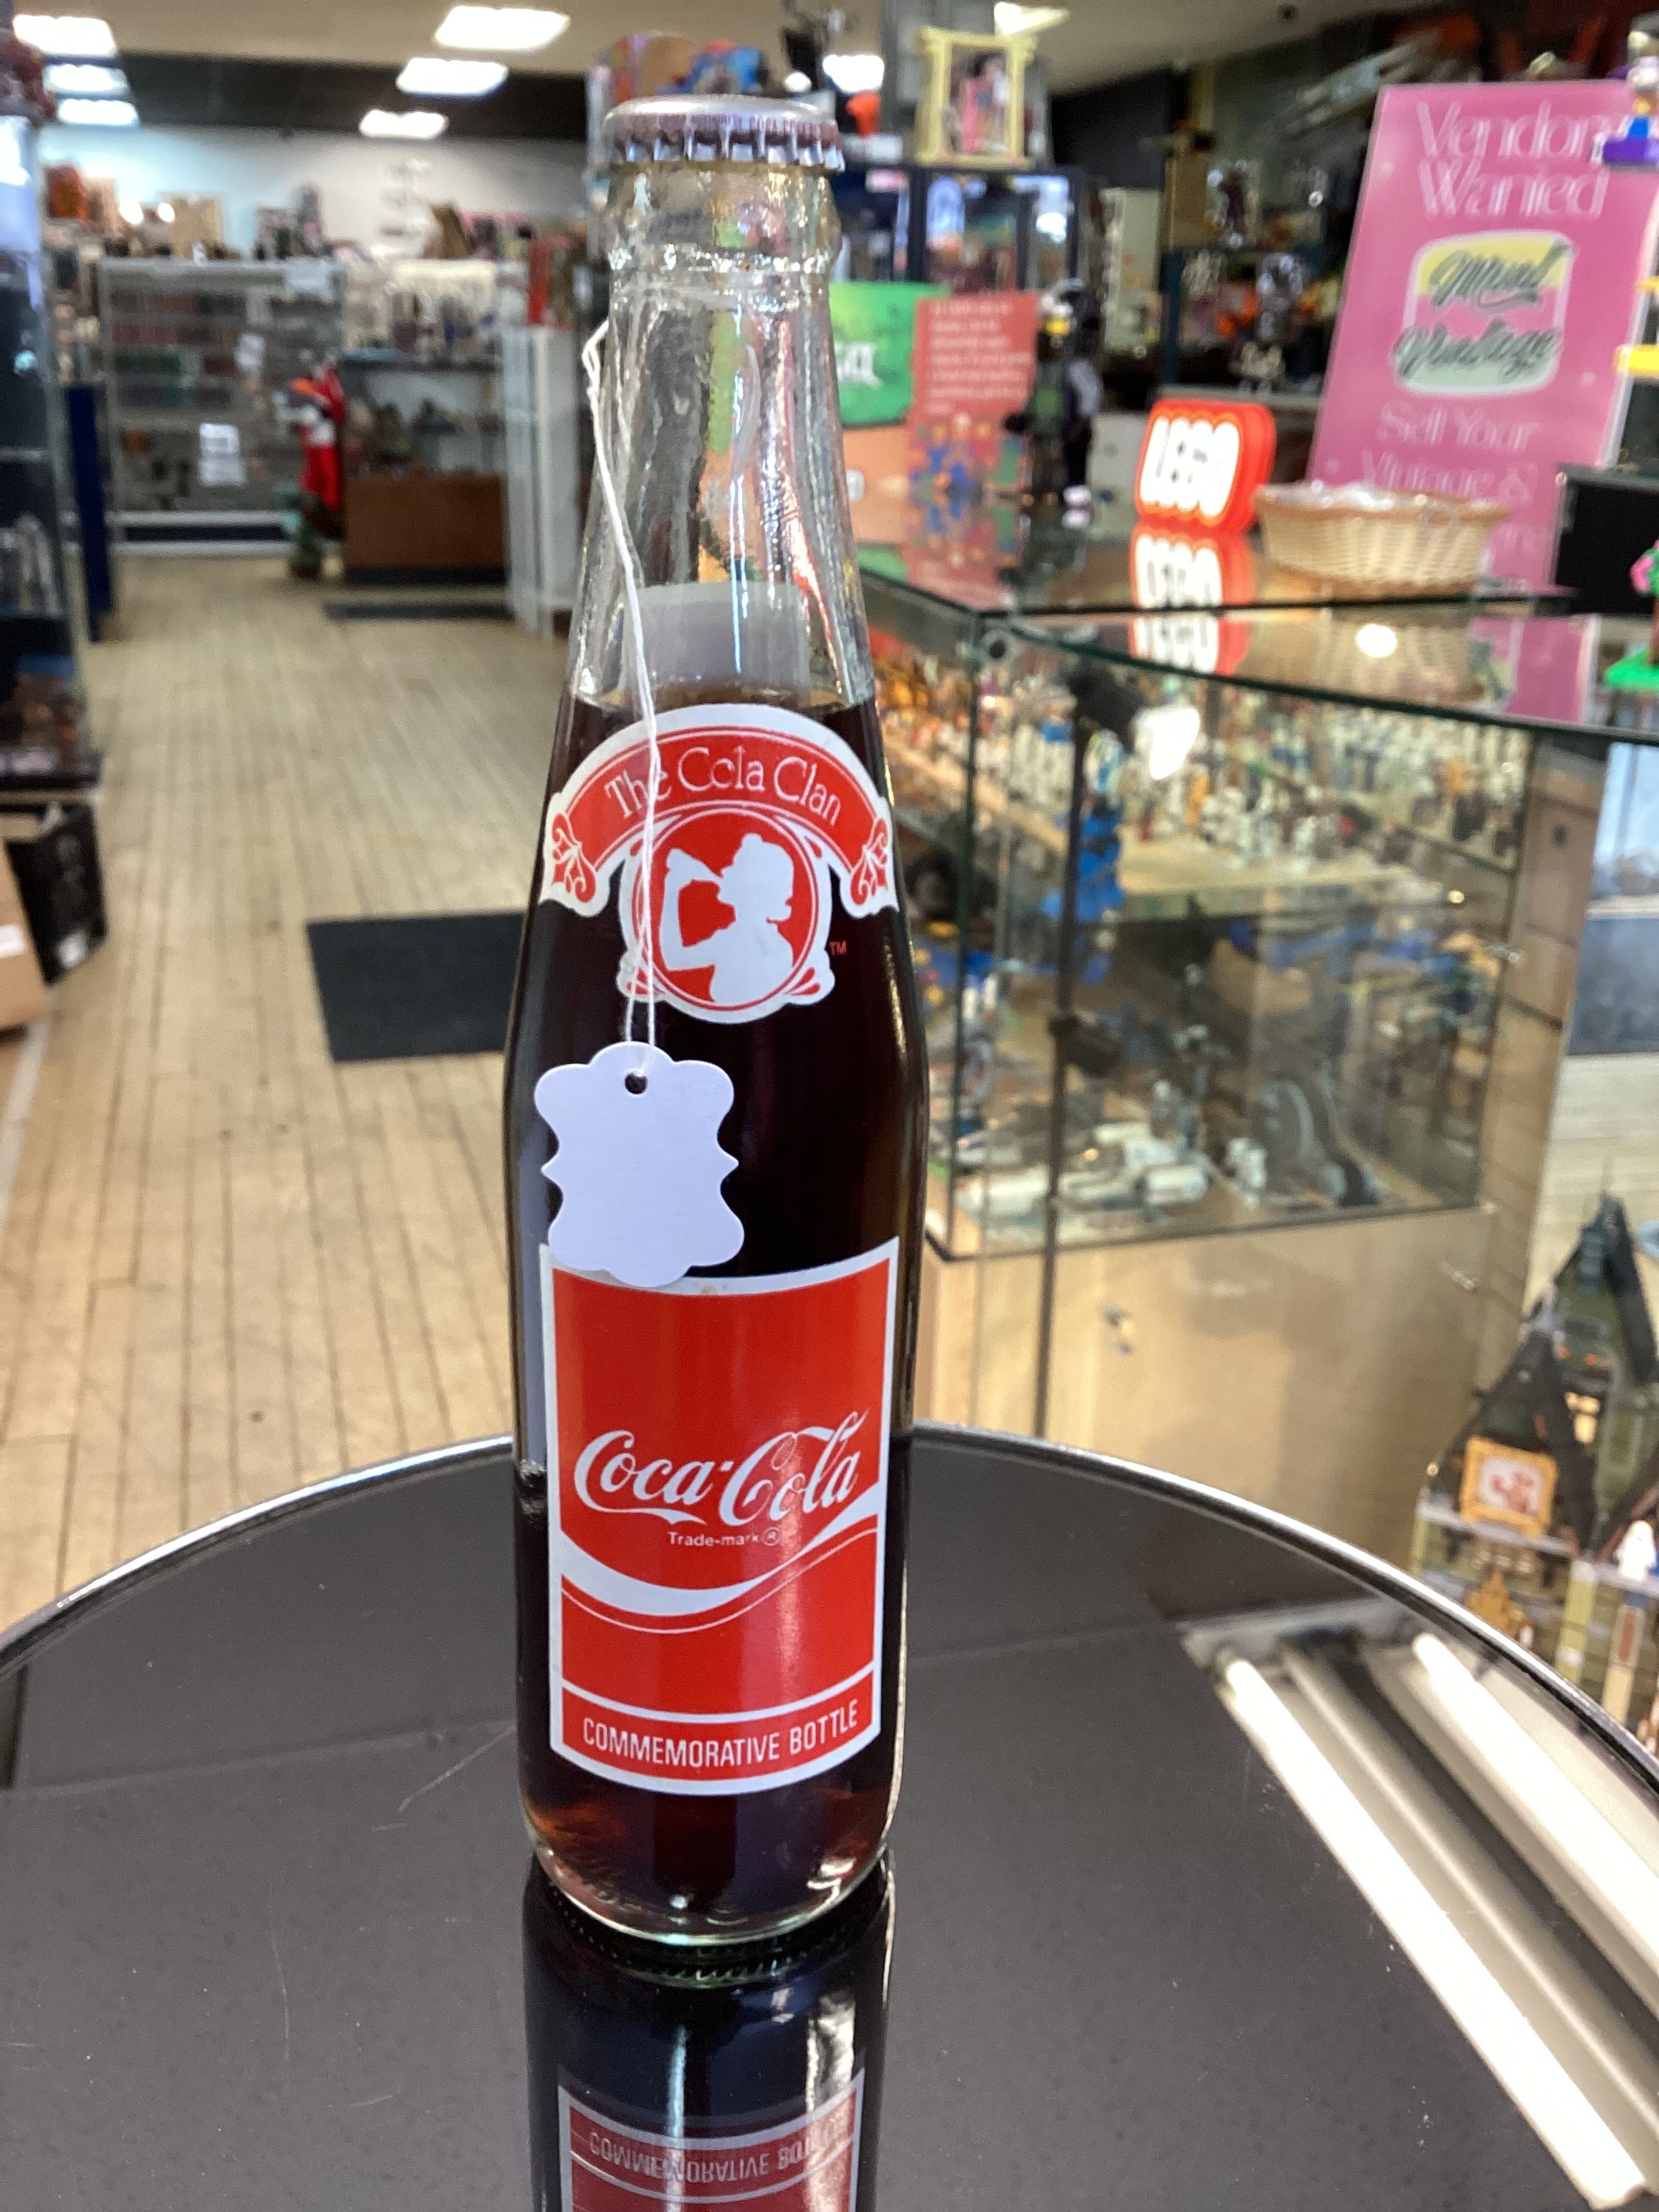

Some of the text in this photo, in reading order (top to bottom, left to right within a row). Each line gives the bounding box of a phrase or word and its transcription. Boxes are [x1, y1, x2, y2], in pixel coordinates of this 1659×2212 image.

[605, 745, 842, 827] The Cola Clan
[830, 941, 847, 956] TM
[574, 1407, 870, 1527] Coca-Cola
[668, 1531, 759, 1547] Trade-mark
[583, 1699, 858, 1768] COMMEMORATIVE BOTTLE
